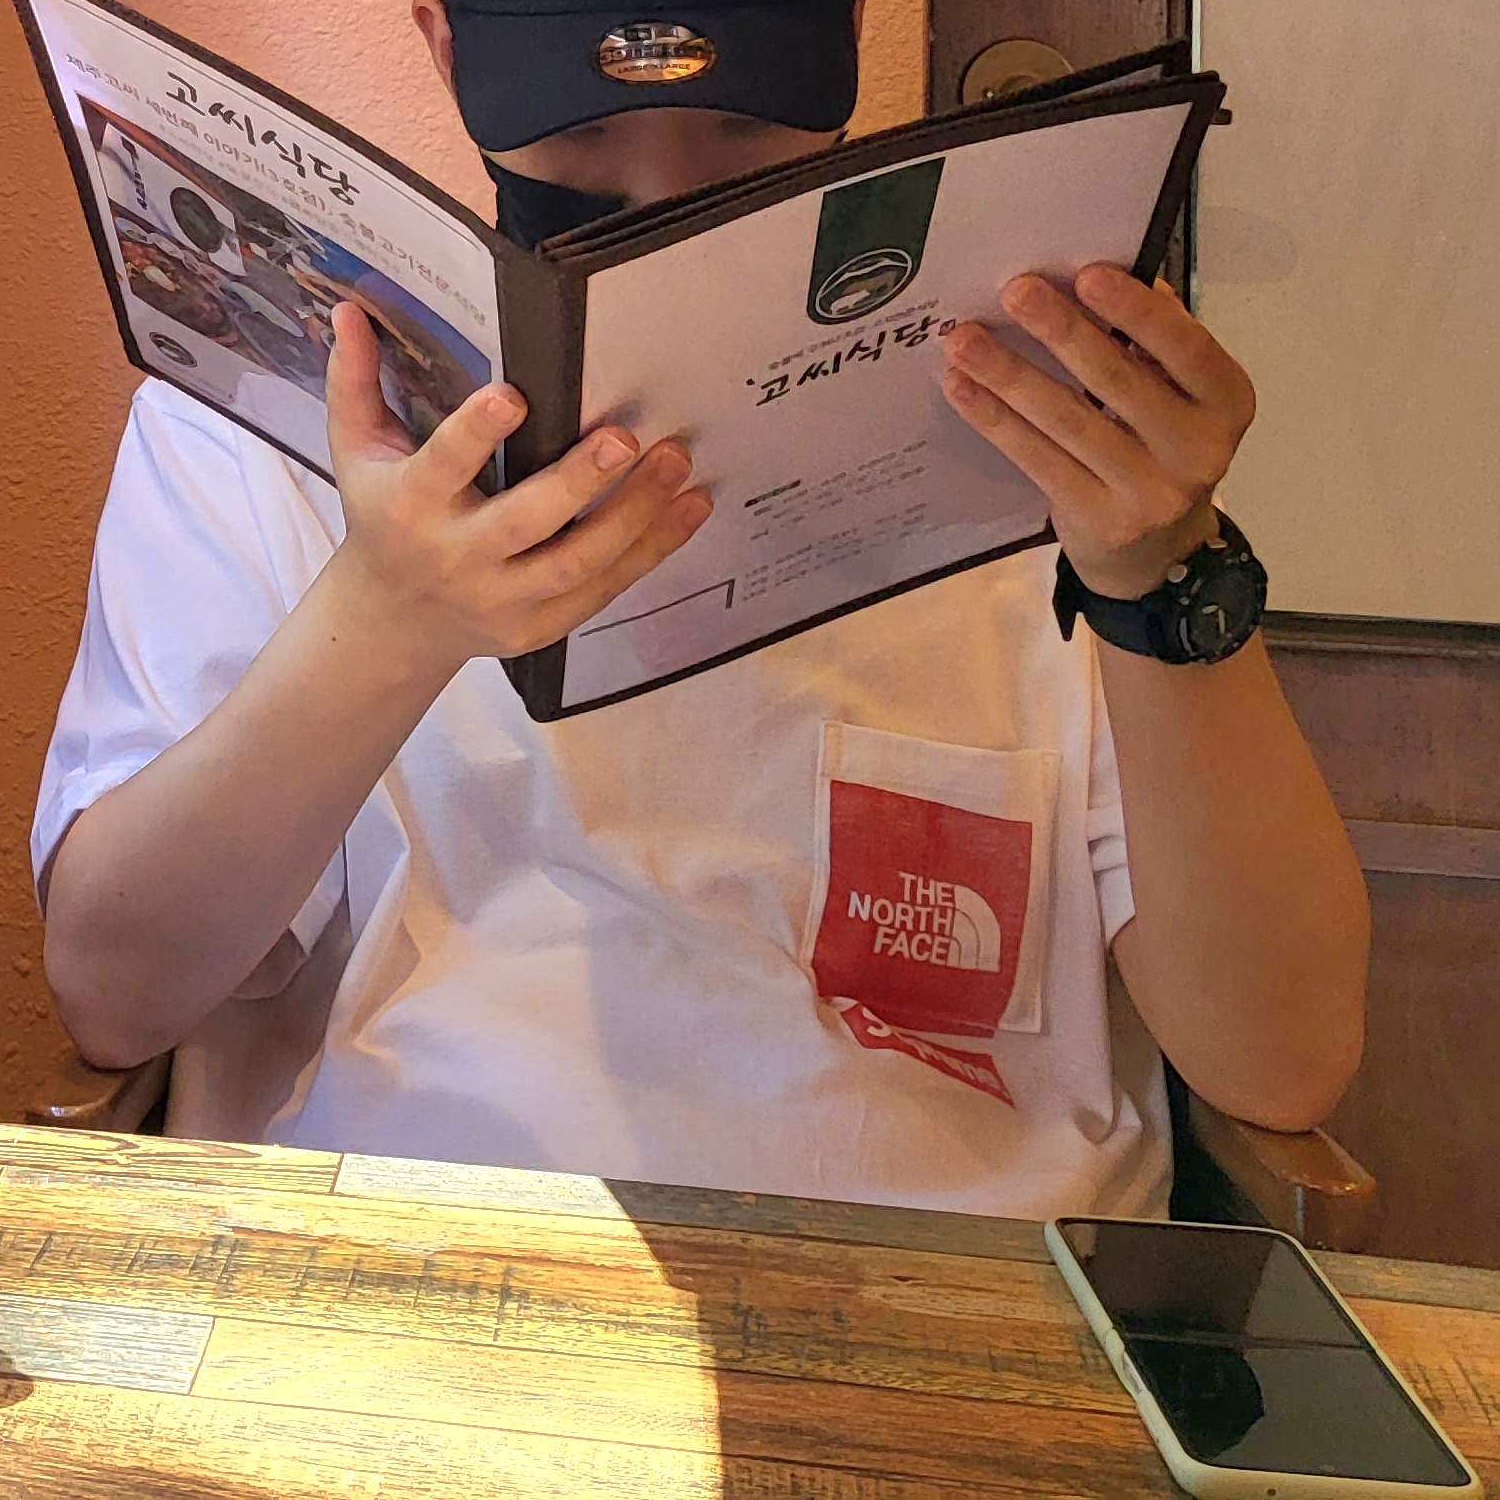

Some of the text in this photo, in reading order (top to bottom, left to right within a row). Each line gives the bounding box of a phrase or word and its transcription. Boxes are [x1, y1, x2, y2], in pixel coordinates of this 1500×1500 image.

[166, 71, 360, 206] 고씨식당
[756, 315, 940, 407] 고씨식당
[899, 871, 956, 908] THE
[847, 891, 954, 934] NORTH
[873, 928, 951, 966] FACE
